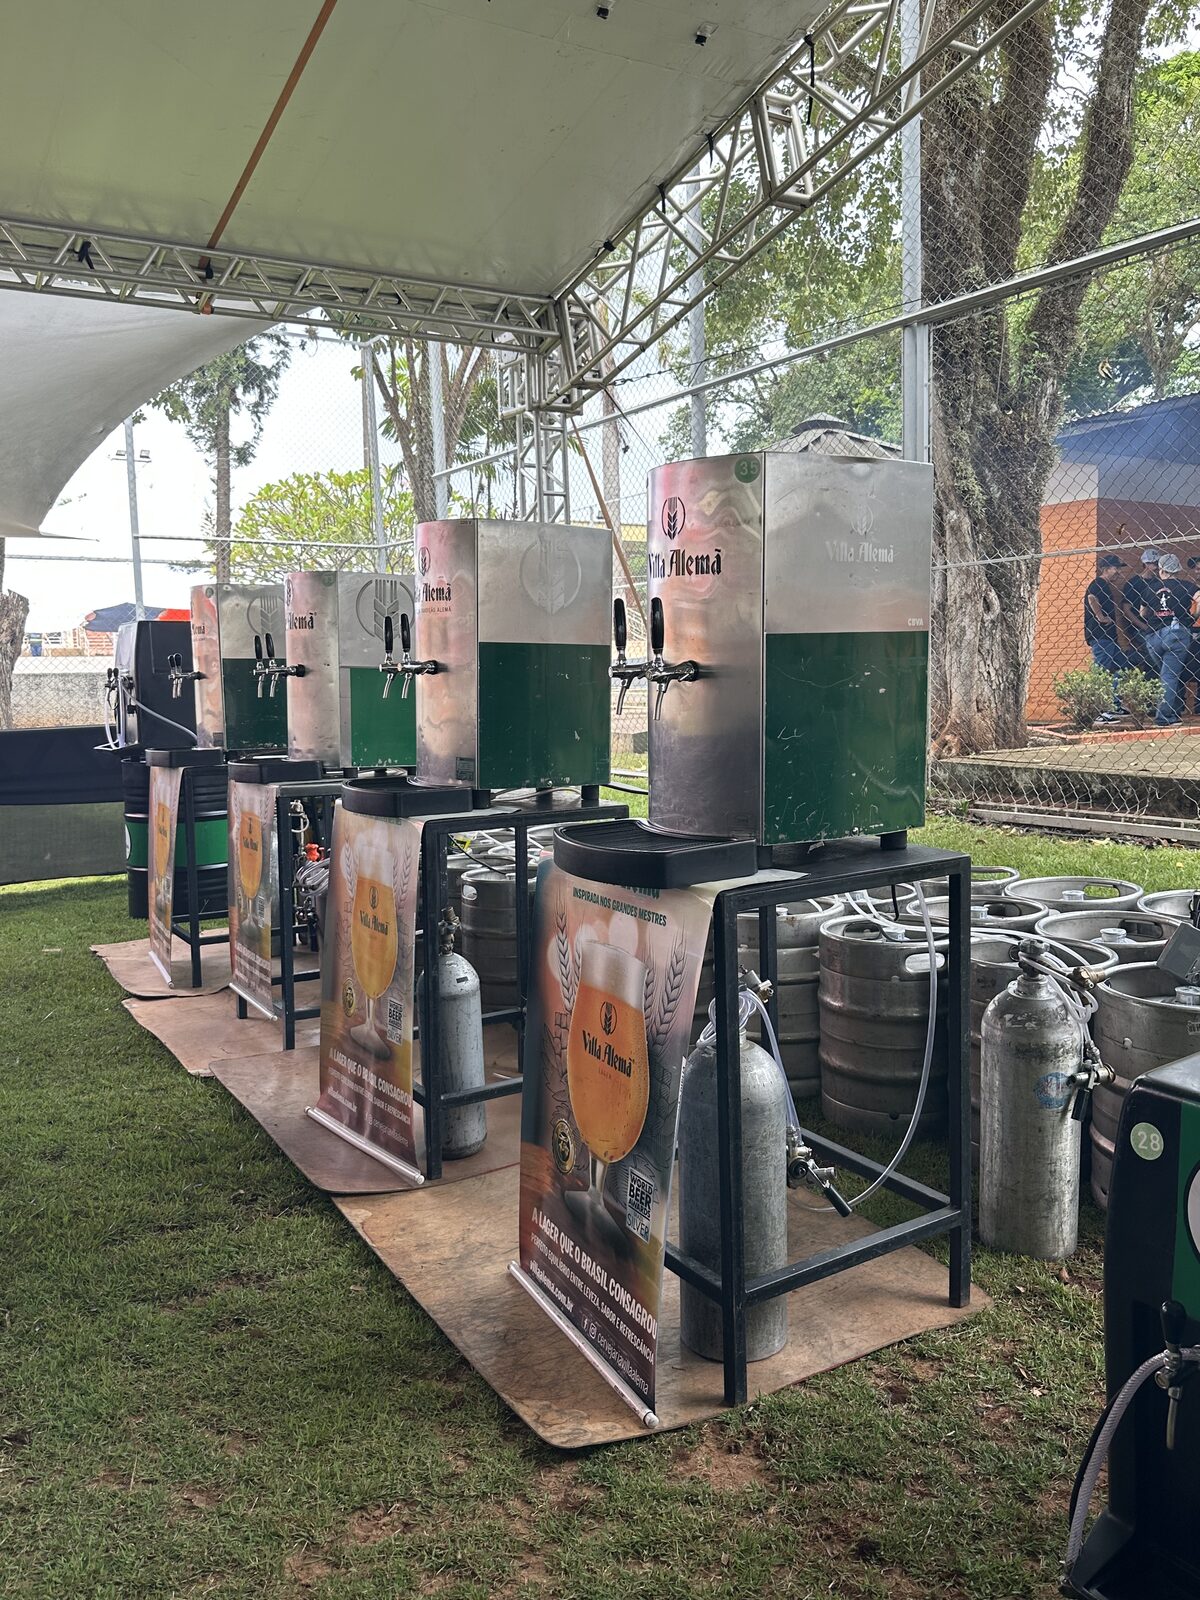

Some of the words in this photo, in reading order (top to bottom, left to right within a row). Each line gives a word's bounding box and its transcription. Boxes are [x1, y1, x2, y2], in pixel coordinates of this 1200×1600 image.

[740, 460, 759, 476] 35
[667, 548, 722, 577] Alemã
[825, 540, 855, 562] Villa
[856, 541, 895, 563] Alemã
[422, 582, 452, 602] Alemã
[573, 886, 600, 905] INSPIRADA
[599, 895, 612, 909] NOS
[612, 899, 638, 918] GRANDES
[638, 907, 667, 927] MESTRES
[389, 1008, 403, 1021] BEER
[582, 1029, 601, 1061] Villa
[601, 1041, 632, 1078] Alemã
[357, 1063, 363, 1077] O
[377, 1077, 412, 1108] CONSAGROU
[1137, 1130, 1161, 1152] 28
[629, 1183, 652, 1211] BEER
[630, 1174, 653, 1195] WORLD
[628, 1197, 651, 1218] AWARDS
[626, 1212, 650, 1243] SILVER
[531, 1206, 538, 1224] A
[538, 1210, 560, 1244] LAGER
[559, 1231, 575, 1258] QUE
[574, 1245, 581, 1264] O
[581, 1251, 608, 1292] BRASIL
[608, 1277, 658, 1340] CONSAGROU
[569, 1270, 584, 1293] ENTRE
[583, 1283, 601, 1311] LEVEZA,
[600, 1301, 617, 1325] SABOR
